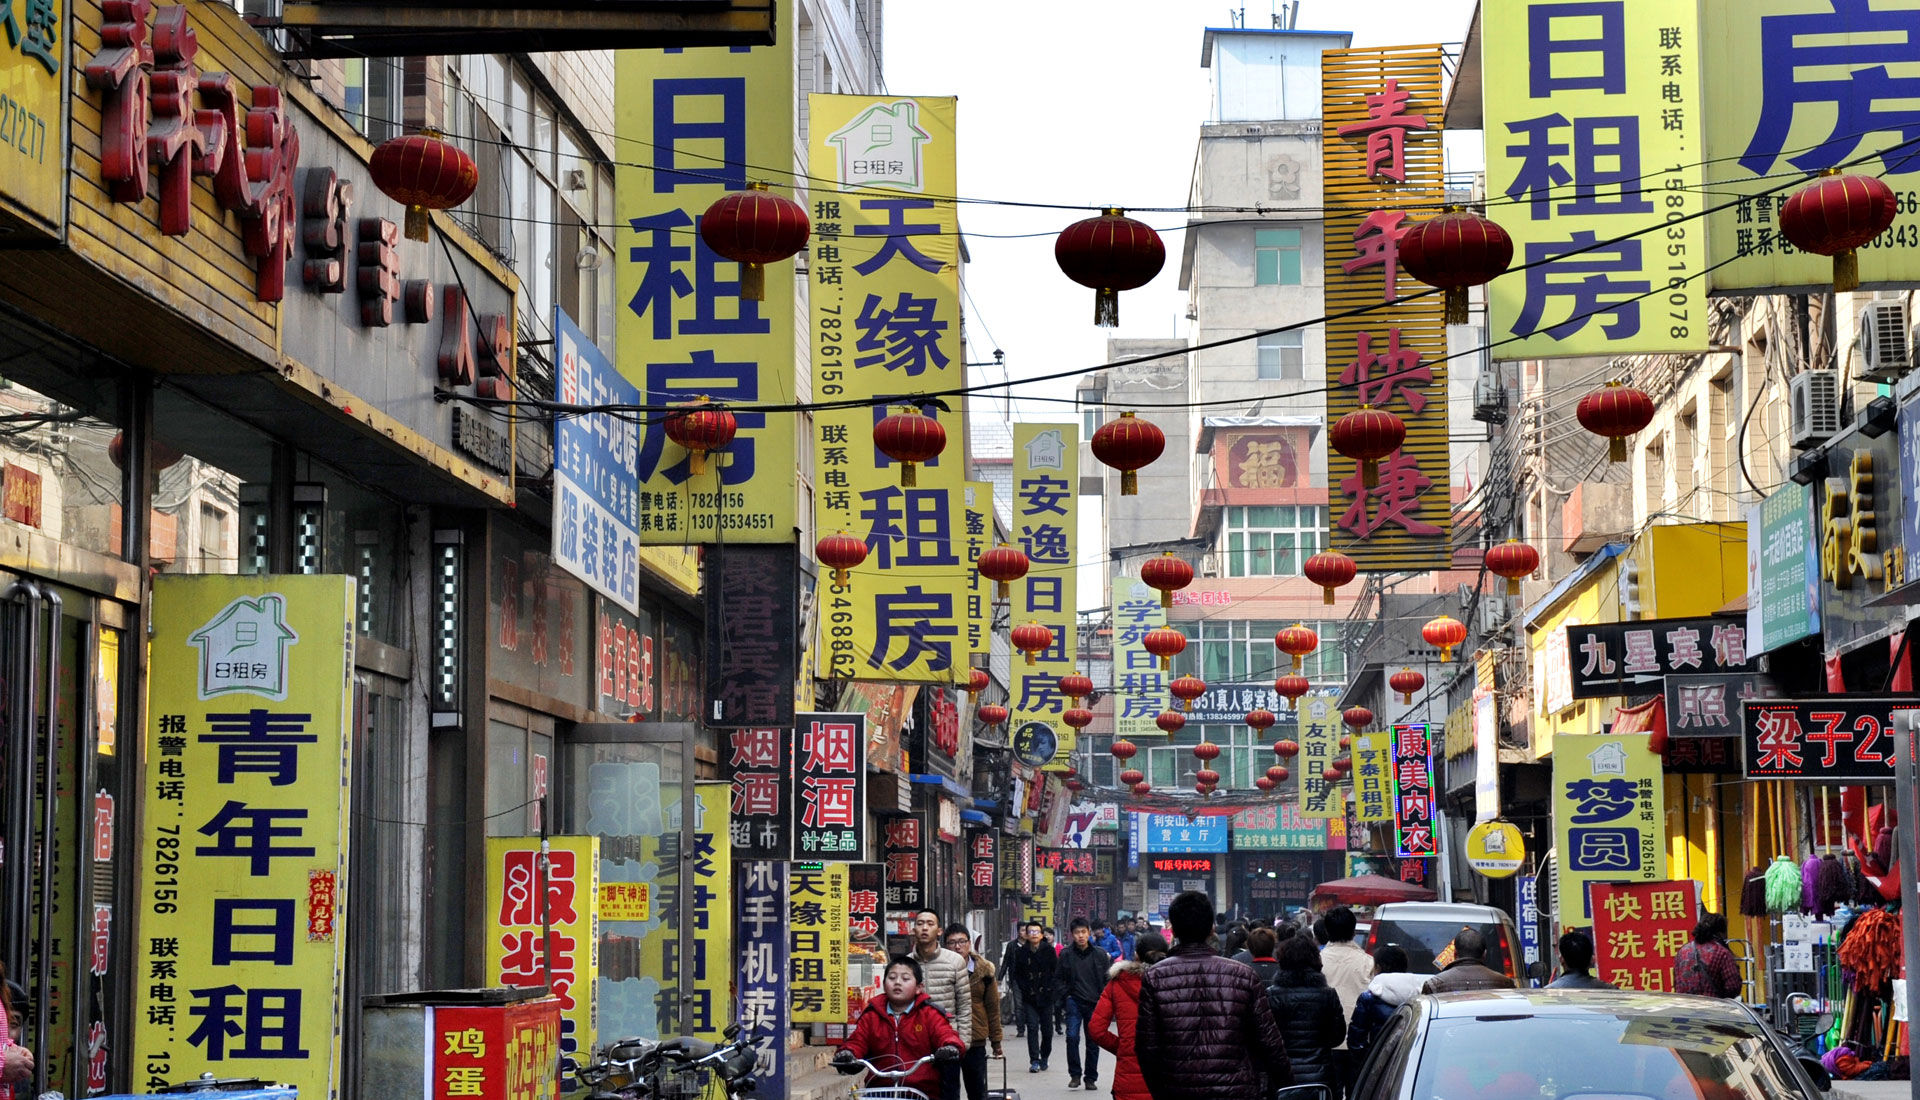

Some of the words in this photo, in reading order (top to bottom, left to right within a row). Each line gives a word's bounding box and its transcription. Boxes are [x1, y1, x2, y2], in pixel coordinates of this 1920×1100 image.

[1737, 0, 1920, 178] 房
[852, 160, 904, 175] 日租房
[1505, 1, 1655, 342] 日租房
[628, 77, 770, 486] 日租房
[1337, 78, 1444, 540] 青年快捷
[579, 355, 637, 480] 日丰地暖
[585, 456, 607, 498] PVC
[561, 487, 637, 605] 服装鞋店
[1016, 475, 1074, 714] 安逸日租房
[215, 662, 268, 680] 日租房
[1580, 624, 1747, 677] 九星宾馆
[729, 728, 781, 817] 烟酒
[1304, 723, 1329, 813] 友谊日租房
[1755, 709, 1896, 769] 梁子2
[801, 721, 857, 829] 烟酒
[1357, 750, 1385, 818] 亨泰日租房
[1397, 728, 1434, 852] 康美内衣
[729, 820, 781, 850] 超市
[801, 830, 857, 852] 计生品
[885, 818, 919, 883] 烟酒
[972, 834, 994, 887] 住宿
[1162, 829, 1209, 842] 营业厅
[1235, 834, 1268, 847] 五金交电
[1271, 834, 1288, 847] 灶具
[1291, 834, 1324, 847] 儿童玩具
[186, 709, 319, 1062] 青年日租
[312, 879, 332, 933] 出門見喜
[886, 886, 920, 905] 超市
[740, 861, 779, 1078] 讯手机卖场
[790, 873, 827, 1013] 天缘日租房
[1607, 928, 1691, 960] 洗相
[444, 1027, 486, 1097] 鸡蛋
